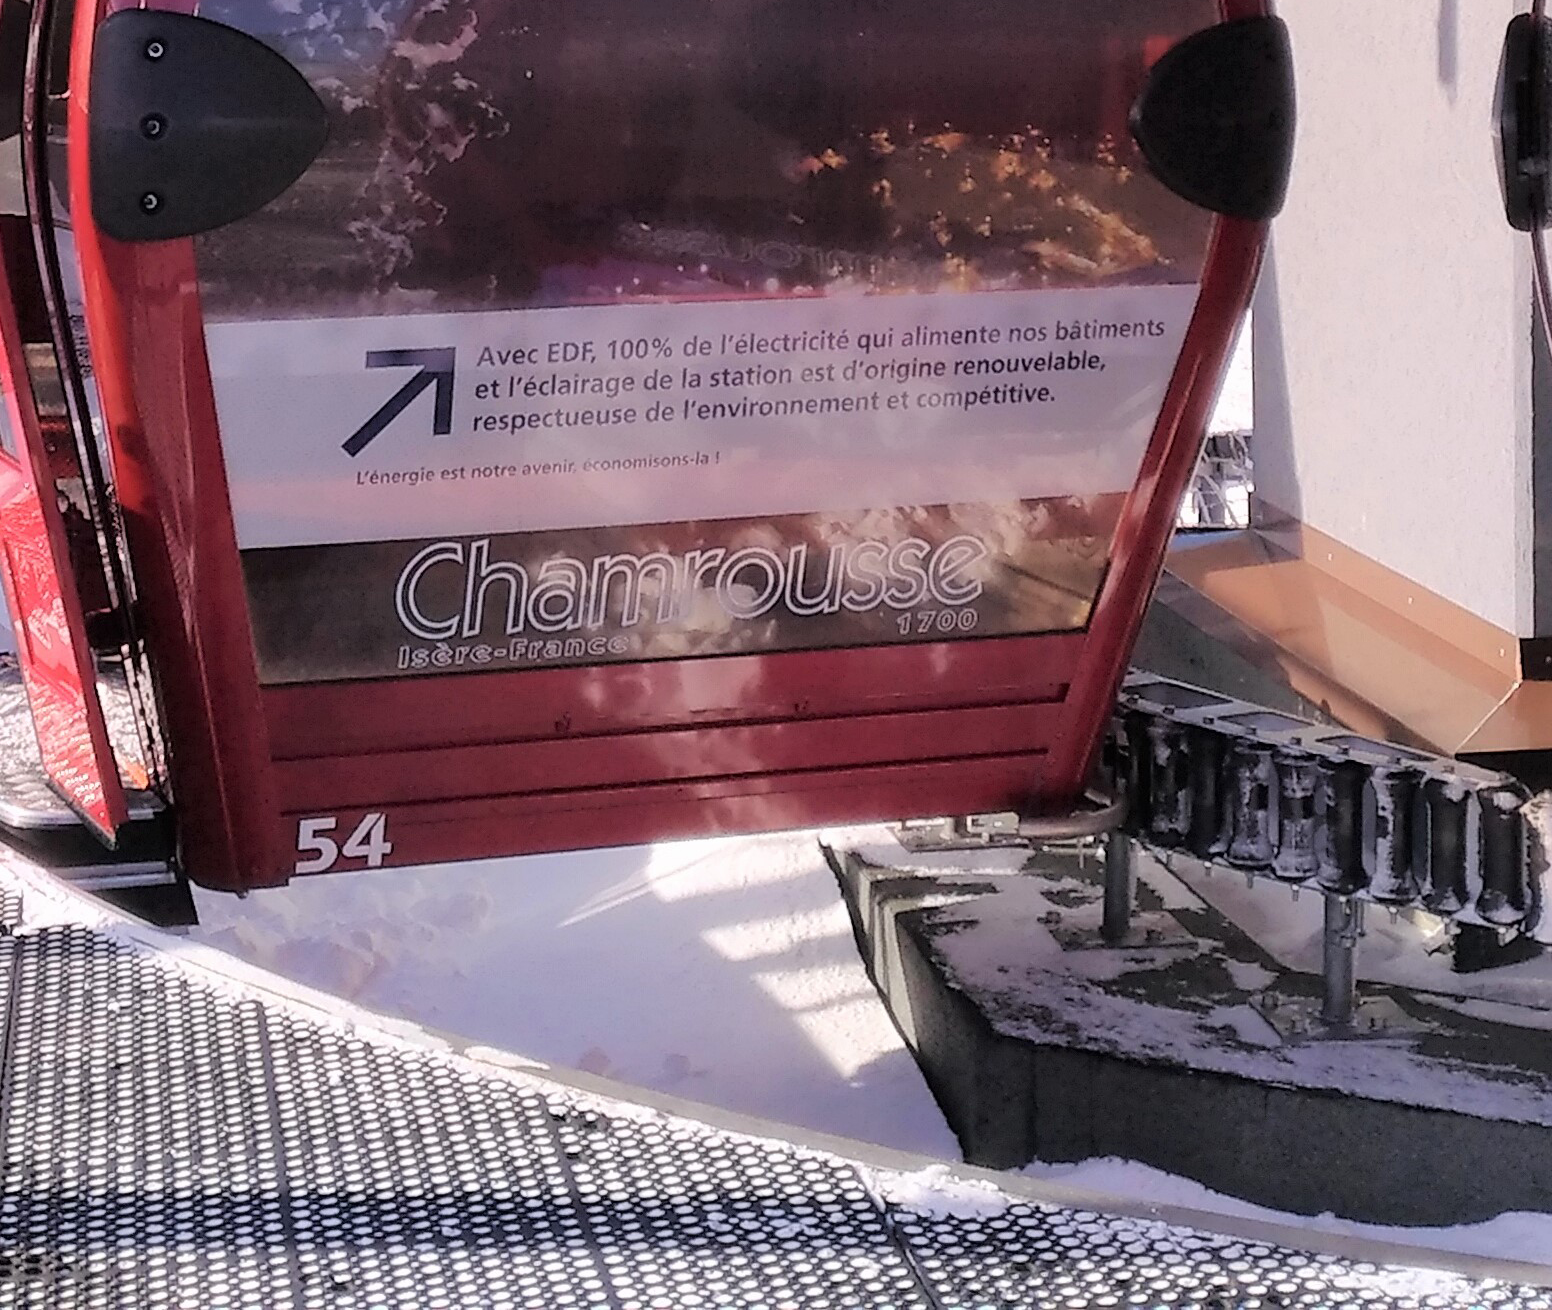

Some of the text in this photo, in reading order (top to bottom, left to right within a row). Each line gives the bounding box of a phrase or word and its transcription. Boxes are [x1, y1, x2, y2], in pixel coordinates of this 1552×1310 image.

[476, 318, 1166, 368] Avec EDF, 100% de l'électricité qui alimente nos bâtiments
[475, 351, 1106, 400] et l'éclairage de la station est d'origine renouvelable,
[472, 384, 1056, 436] respectueuse de l'environnement et compétitive.
[356, 468, 435, 487] L'énergie
[440, 467, 466, 481] est
[471, 464, 517, 479] notre
[582, 452, 710, 473] économisons-la
[395, 534, 988, 641] Chamrousse
[896, 607, 979, 635] 1700
[397, 632, 631, 670] Isère-France
[294, 812, 392, 875] 54
